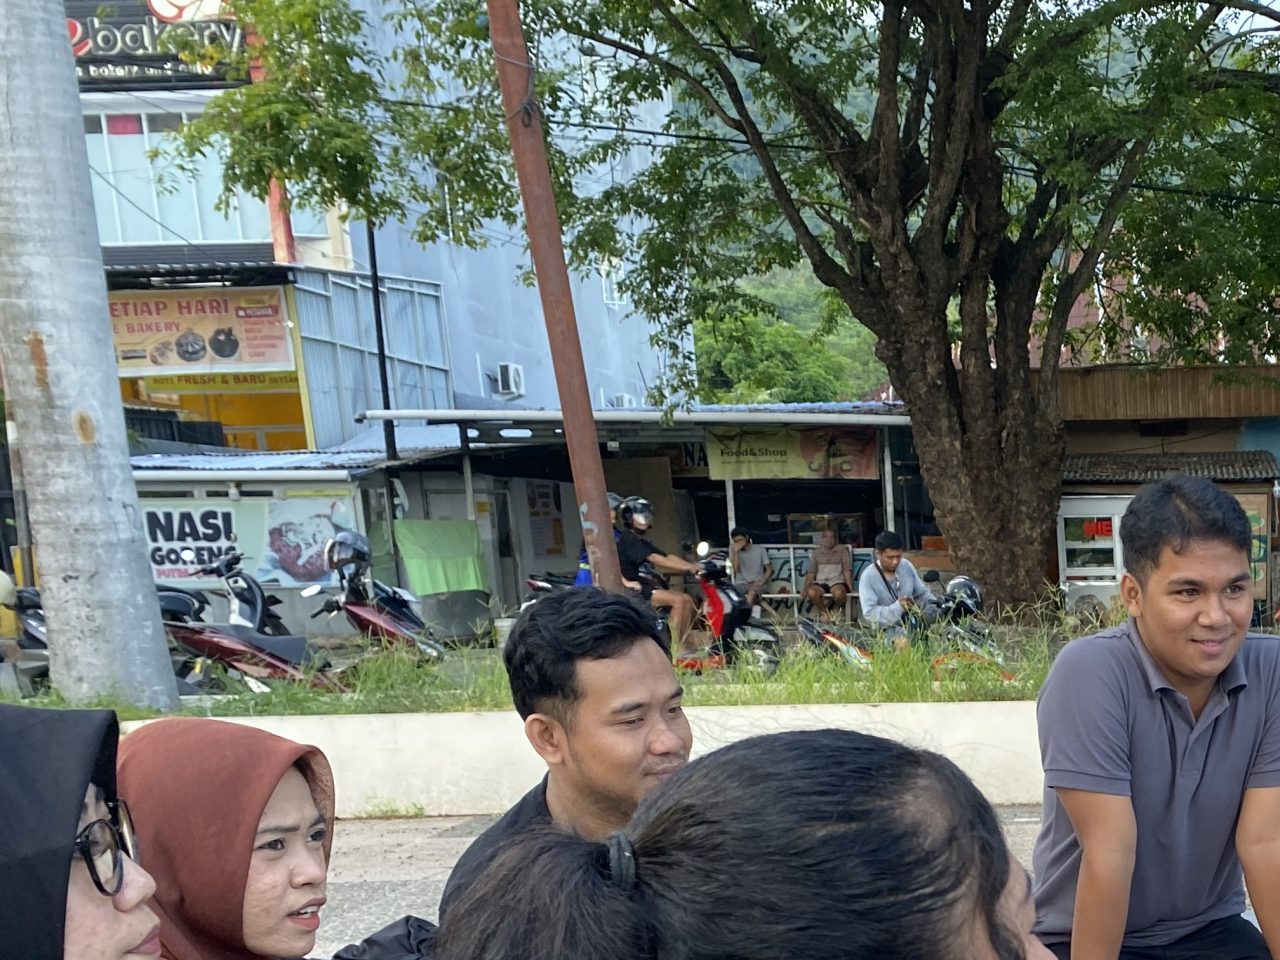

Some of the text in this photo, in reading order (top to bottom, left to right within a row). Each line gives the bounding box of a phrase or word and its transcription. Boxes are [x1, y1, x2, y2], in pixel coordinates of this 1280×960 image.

[109, 299, 229, 317] ETIAP HARI
[126, 321, 181, 334] BAKERY
[177, 375, 215, 385] FRESH
[233, 374, 266, 384] BARU
[146, 510, 233, 542] NASI
